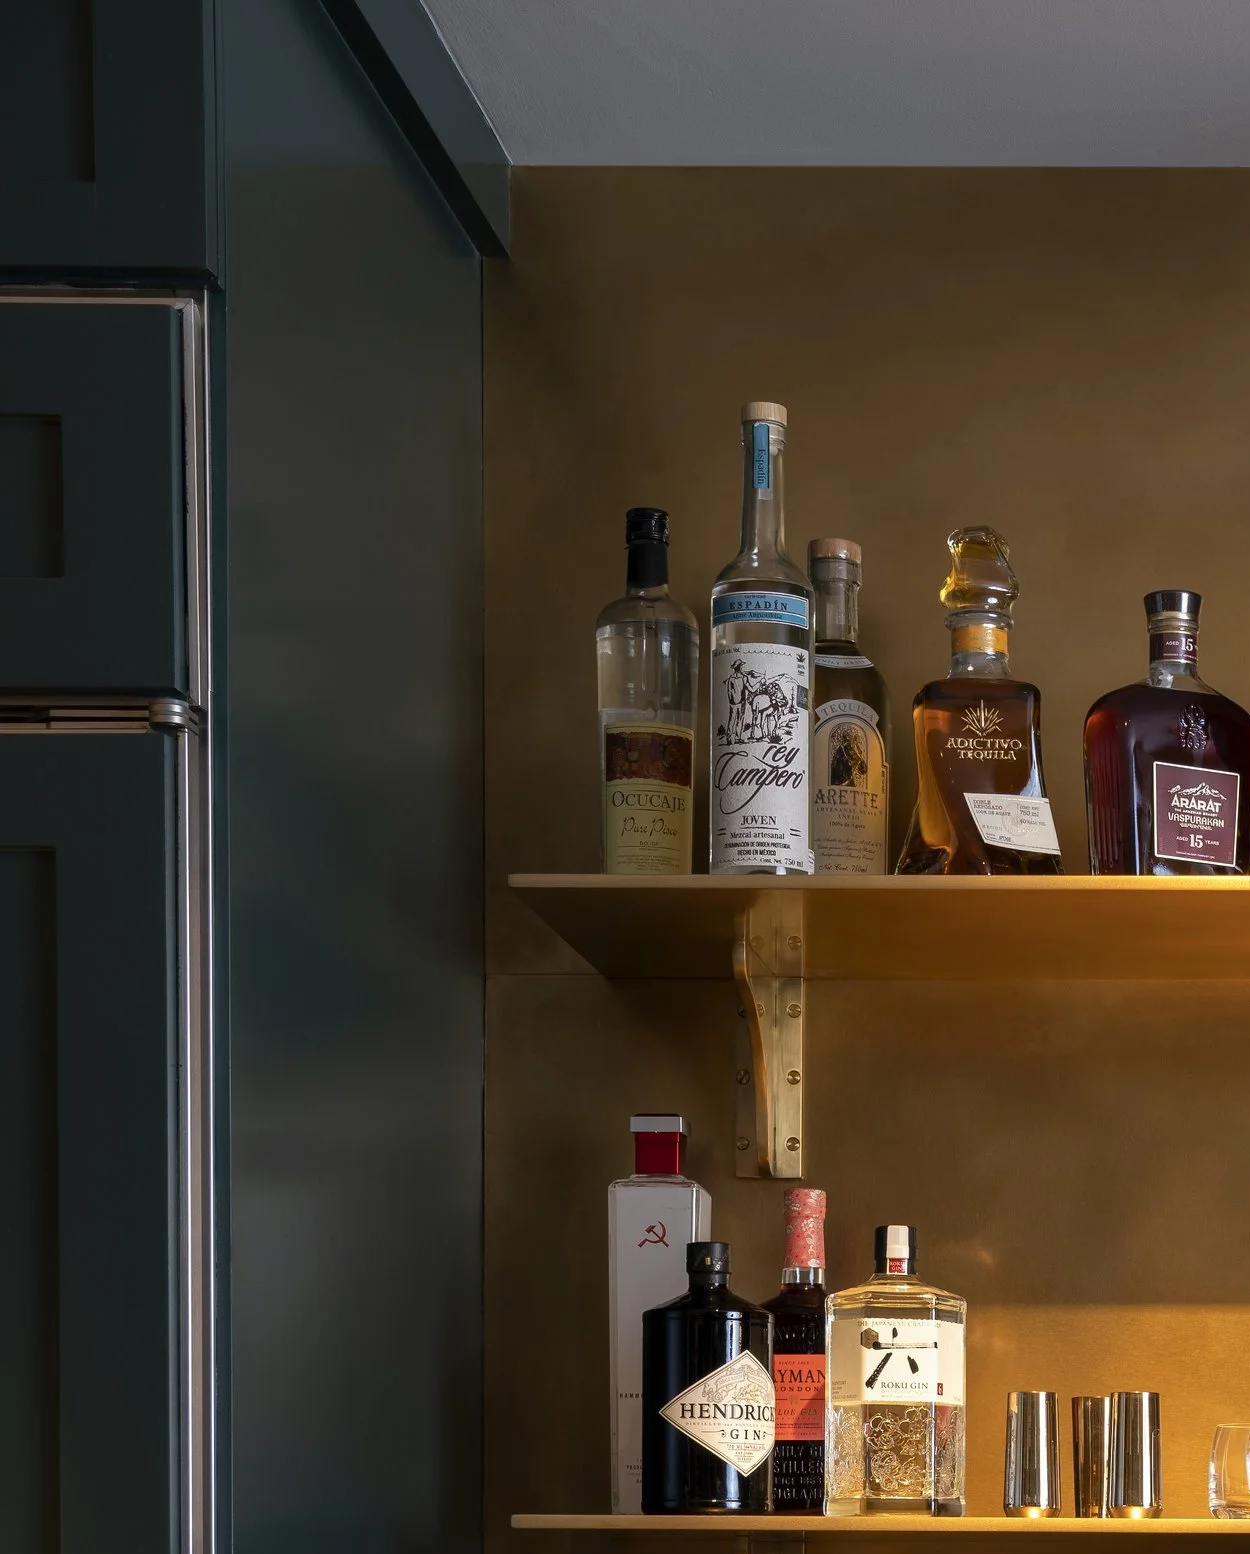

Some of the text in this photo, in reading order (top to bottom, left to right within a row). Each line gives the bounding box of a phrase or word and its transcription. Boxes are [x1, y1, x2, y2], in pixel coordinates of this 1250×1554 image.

[730, 600, 788, 611] ESPADÍN
[1180, 638, 1193, 651] 15
[821, 701, 874, 721] TEQUILA
[945, 738, 1022, 750] ADICTIVO
[753, 745, 801, 769] rey
[958, 750, 1016, 762] TEQUILA
[715, 751, 804, 814] Campero
[612, 791, 685, 812] OCUCAJE
[814, 788, 878, 809] ARETTE
[1171, 794, 1222, 813] ARARAT
[741, 815, 777, 826] JOVEN
[1168, 812, 1225, 828] VASPURAKAN
[753, 832, 785, 840] artesanal
[1190, 834, 1203, 848] 15
[730, 1429, 761, 1440] GIN
